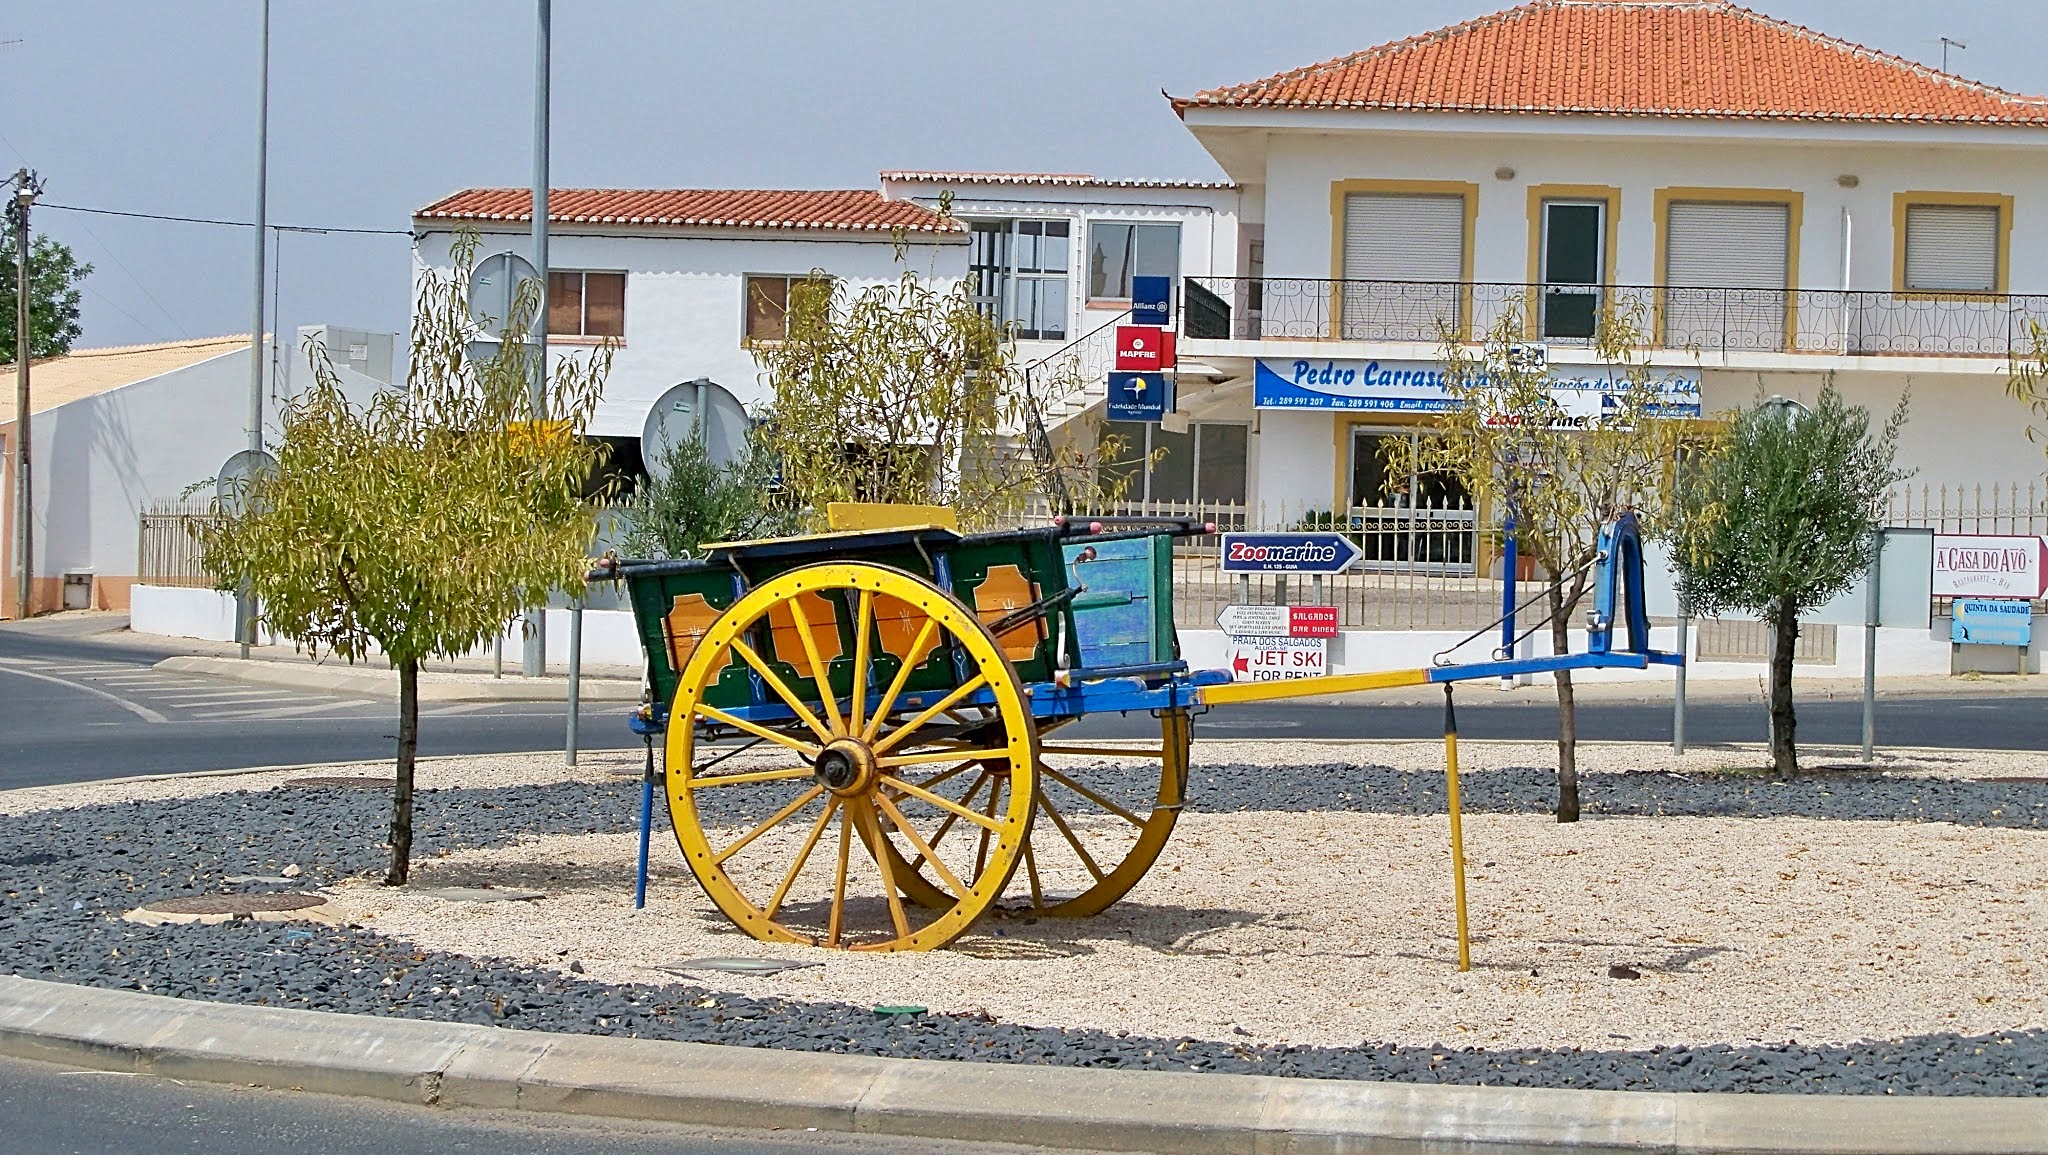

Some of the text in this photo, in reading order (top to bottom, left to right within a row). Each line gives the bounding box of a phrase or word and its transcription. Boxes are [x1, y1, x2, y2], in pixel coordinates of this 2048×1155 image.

[1133, 302, 1156, 310] Allianz
[1119, 350, 1156, 359] MAPFRE
[1292, 360, 1354, 386] Pedro
[1279, 397, 1293, 405] 289
[1294, 397, 1308, 405] 591
[1310, 397, 1324, 406] 207
[1347, 398, 1362, 407] 289
[1364, 399, 1378, 408] 591
[1380, 399, 1394, 408] 406
[1229, 541, 1336, 562] Zoomarine
[1936, 550, 1945, 569] A
[1982, 551, 1998, 570] DO
[1964, 603, 2030, 615] QUINTA DA SAUDADE
[1292, 612, 1334, 621] SALGADOS
[1232, 636, 1322, 648] PRAIA DOS SALGADOS
[1254, 650, 1322, 667] JET SKI
[1253, 669, 1281, 680] FOR
